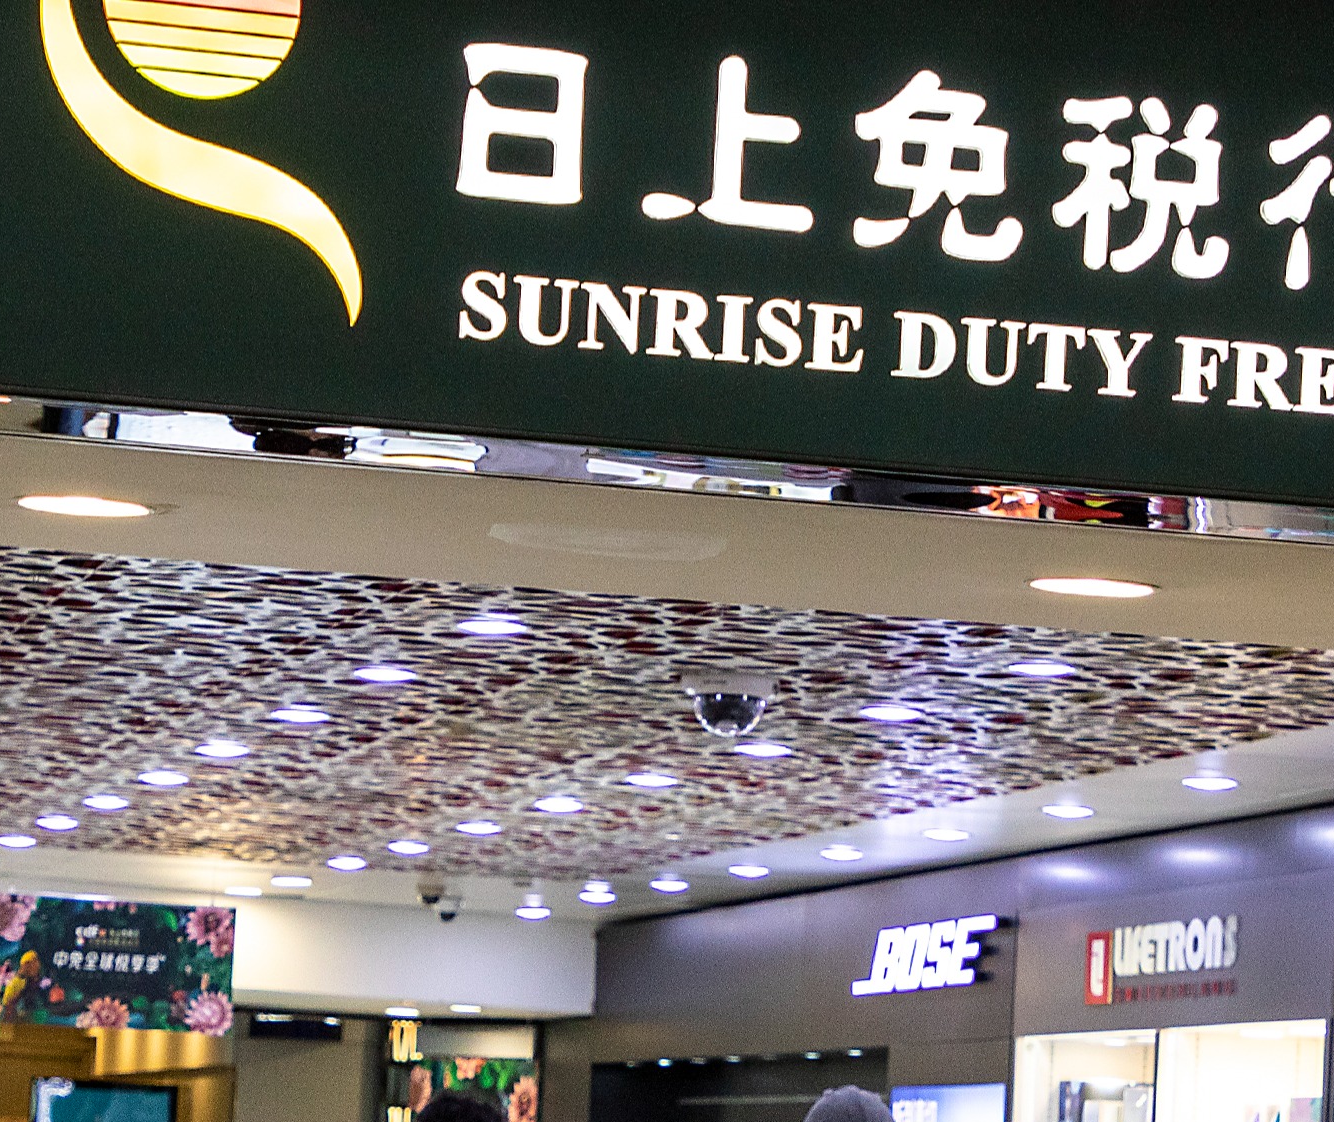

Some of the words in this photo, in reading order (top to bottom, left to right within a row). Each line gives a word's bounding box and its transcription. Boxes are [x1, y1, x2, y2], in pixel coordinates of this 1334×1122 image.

[458, 271, 864, 373] SUNRISE
[890, 310, 1154, 398] DUTY
[851, 913, 998, 997] BOSE
